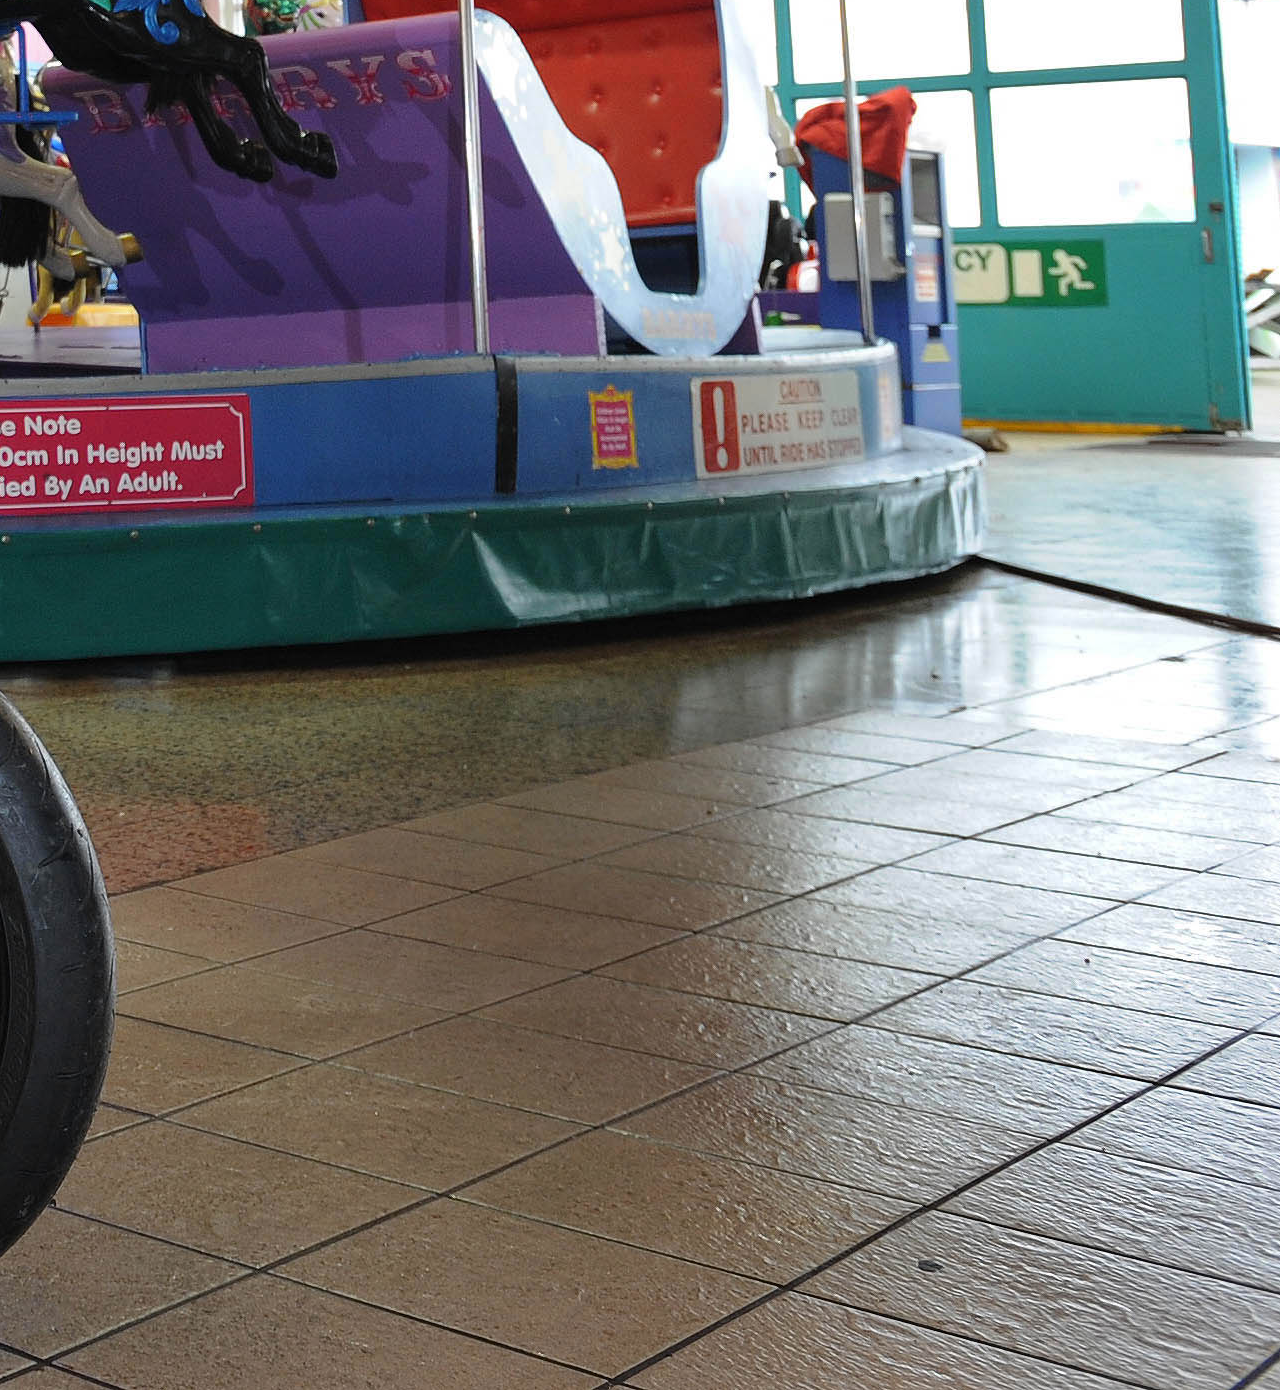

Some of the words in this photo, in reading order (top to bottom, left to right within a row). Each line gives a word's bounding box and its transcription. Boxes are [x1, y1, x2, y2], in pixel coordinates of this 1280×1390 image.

[24, 414, 82, 436] Note
[741, 411, 789, 434] PLEASE
[798, 409, 824, 429] KEEP
[57, 445, 78, 465] In
[87, 441, 164, 467] Height
[171, 439, 225, 461] Must
[743, 446, 777, 467] UNTIL
[780, 444, 805, 464] RIDE
[807, 442, 827, 462] HAS
[44, 475, 72, 500] By
[79, 474, 109, 494] An
[116, 470, 183, 492] Adult.
